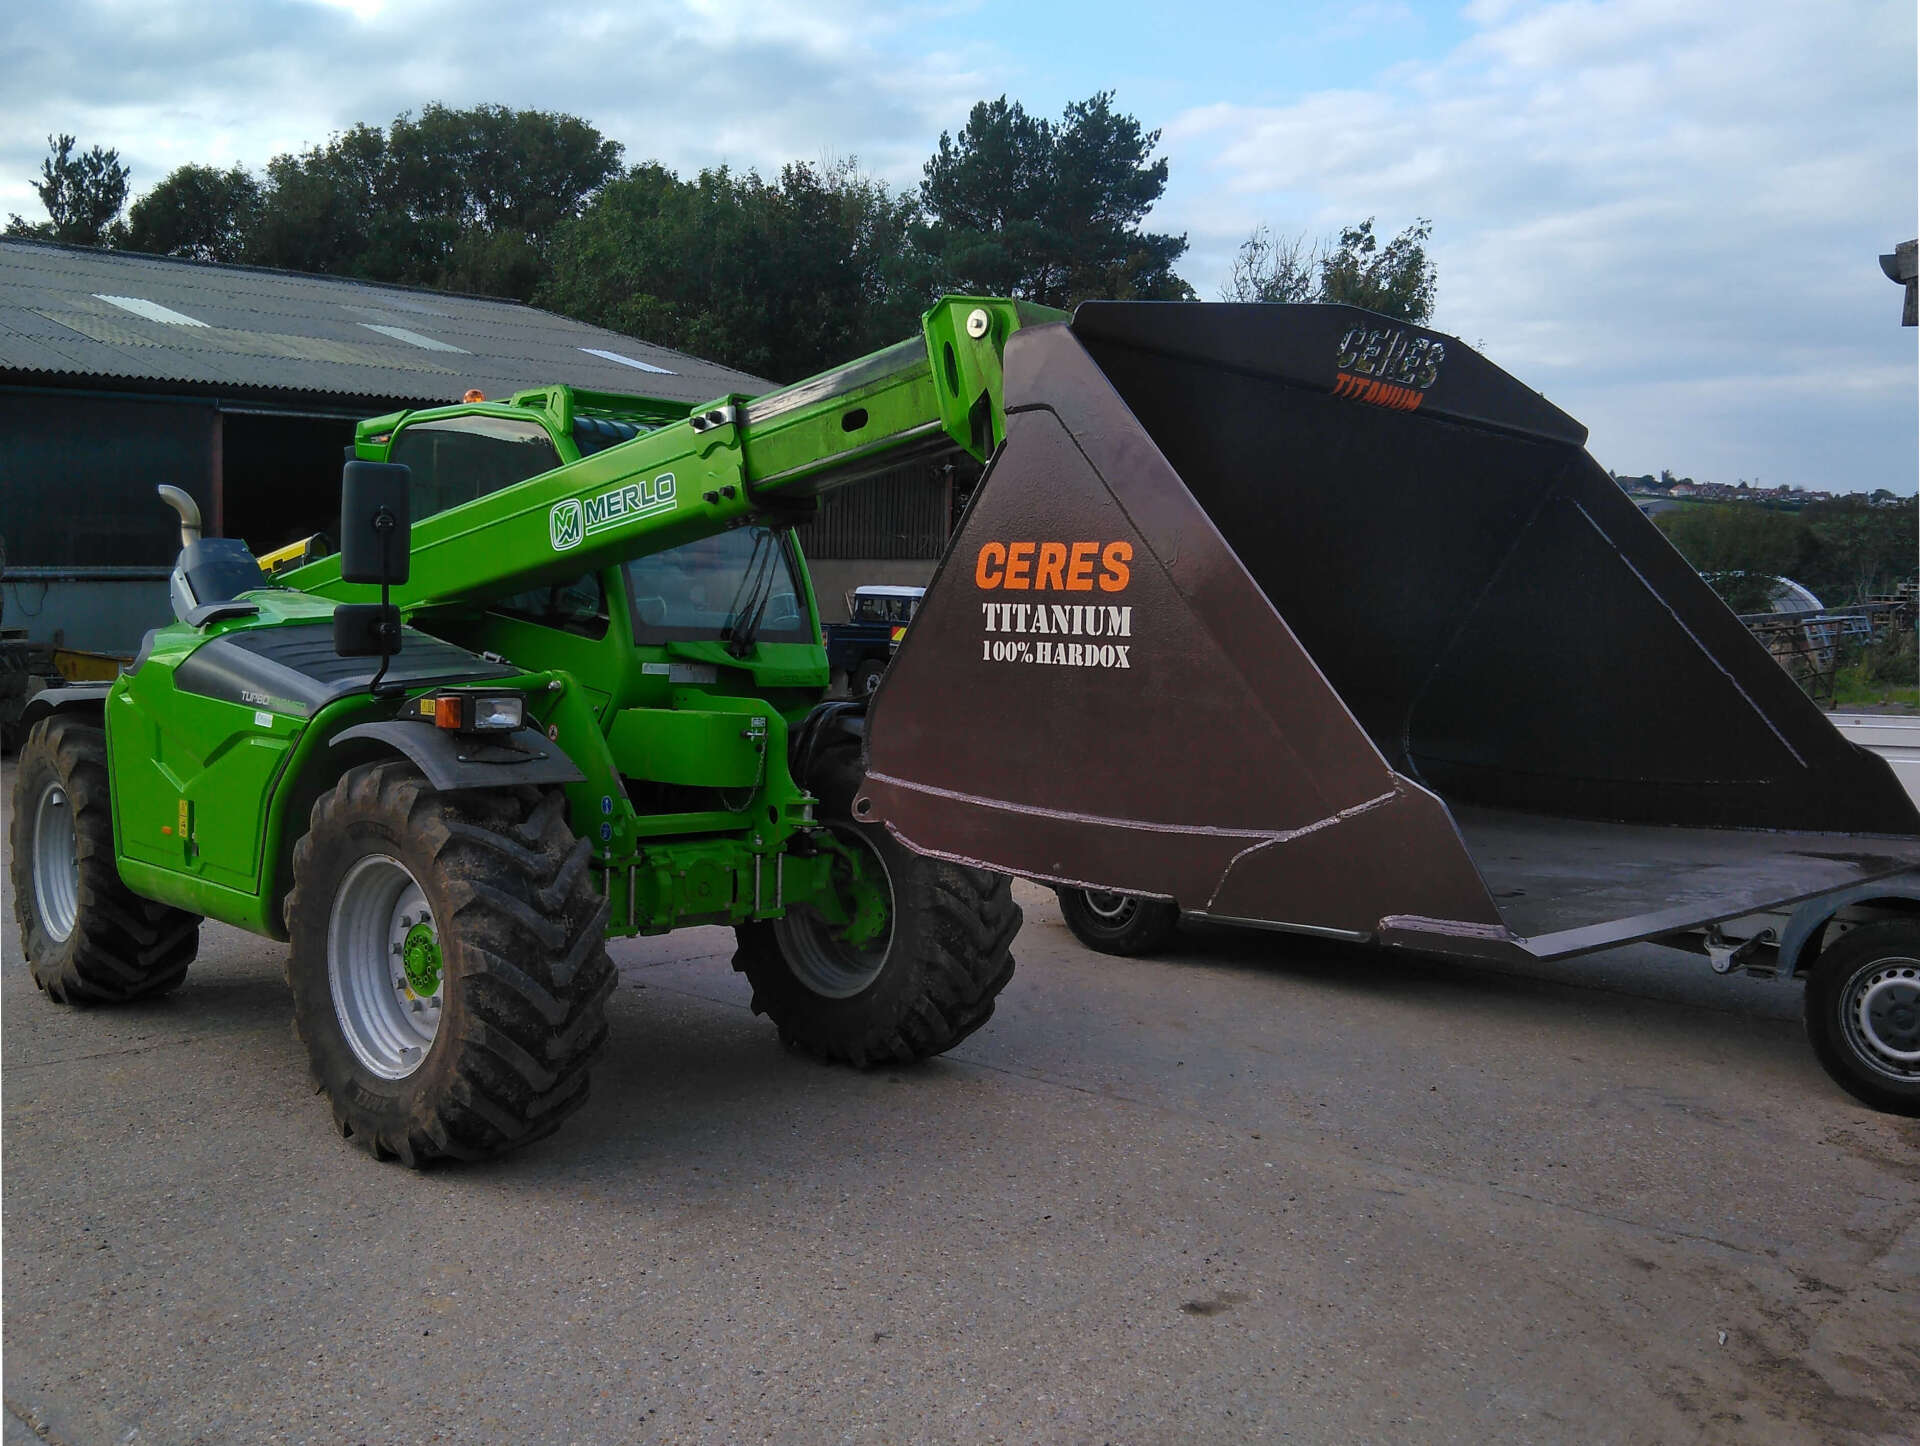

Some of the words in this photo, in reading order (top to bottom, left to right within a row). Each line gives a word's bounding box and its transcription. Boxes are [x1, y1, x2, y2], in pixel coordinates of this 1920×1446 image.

[1332, 372, 1424, 411] TITANIUM
[584, 472, 676, 525] MERLO
[975, 541, 1133, 592] CERES
[982, 603, 1132, 636] TITANIUM
